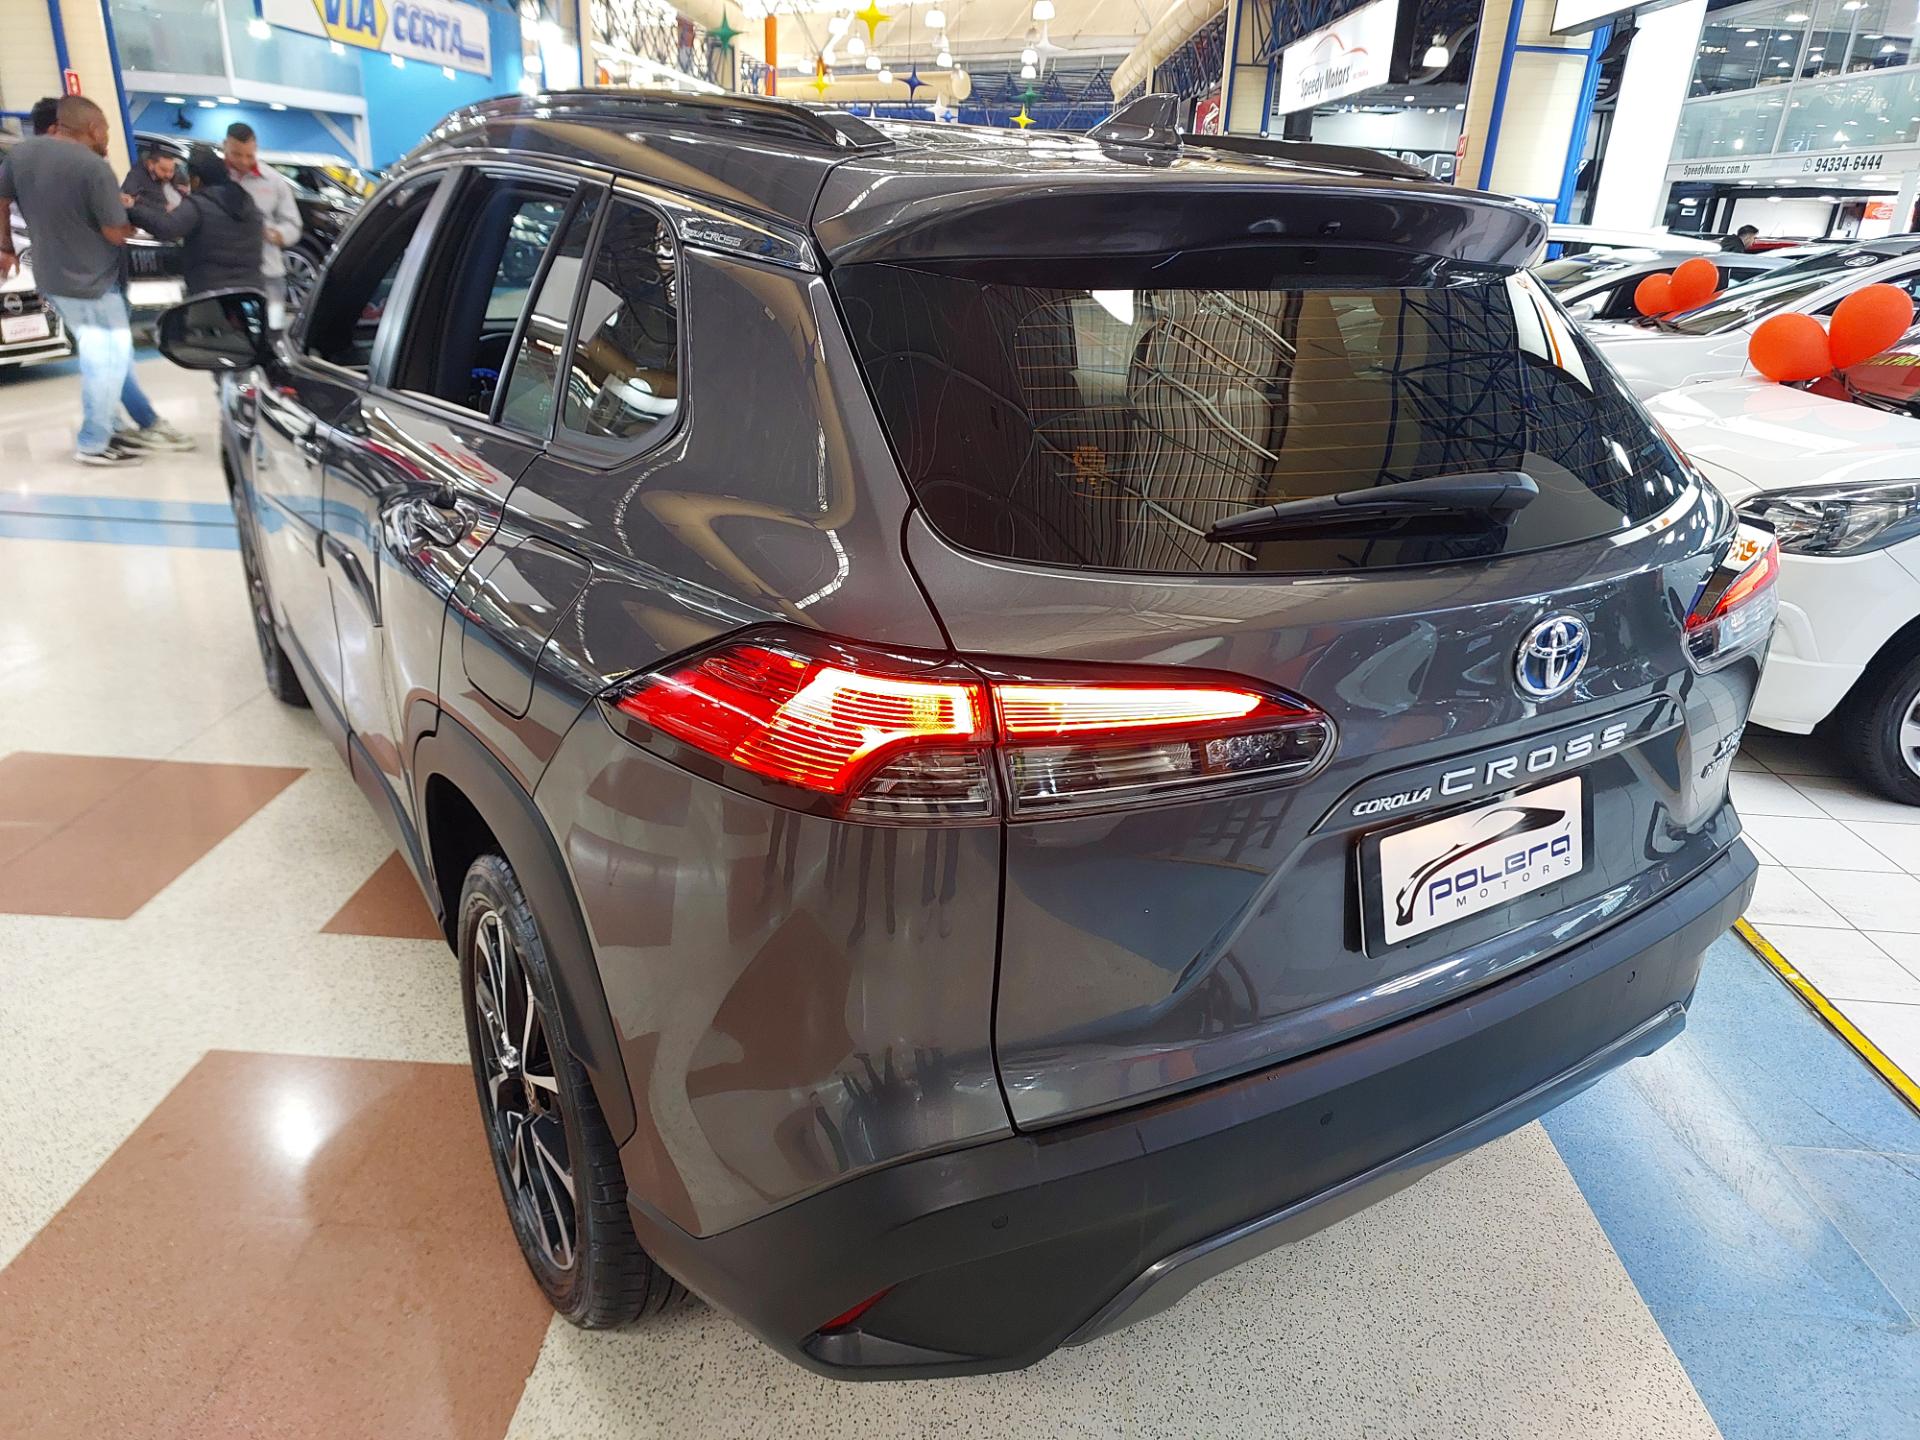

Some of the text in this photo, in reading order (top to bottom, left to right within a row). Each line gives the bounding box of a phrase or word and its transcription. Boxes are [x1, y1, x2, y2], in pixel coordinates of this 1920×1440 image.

[1300, 73, 1324, 101] Speedy
[1324, 65, 1351, 90] Motors
[1683, 154, 1884, 177] SpeedyMotors.com.br 94334-6444
[1352, 722, 1628, 816] COROLLA CROSS
[1456, 856, 1571, 908] MOTORS
